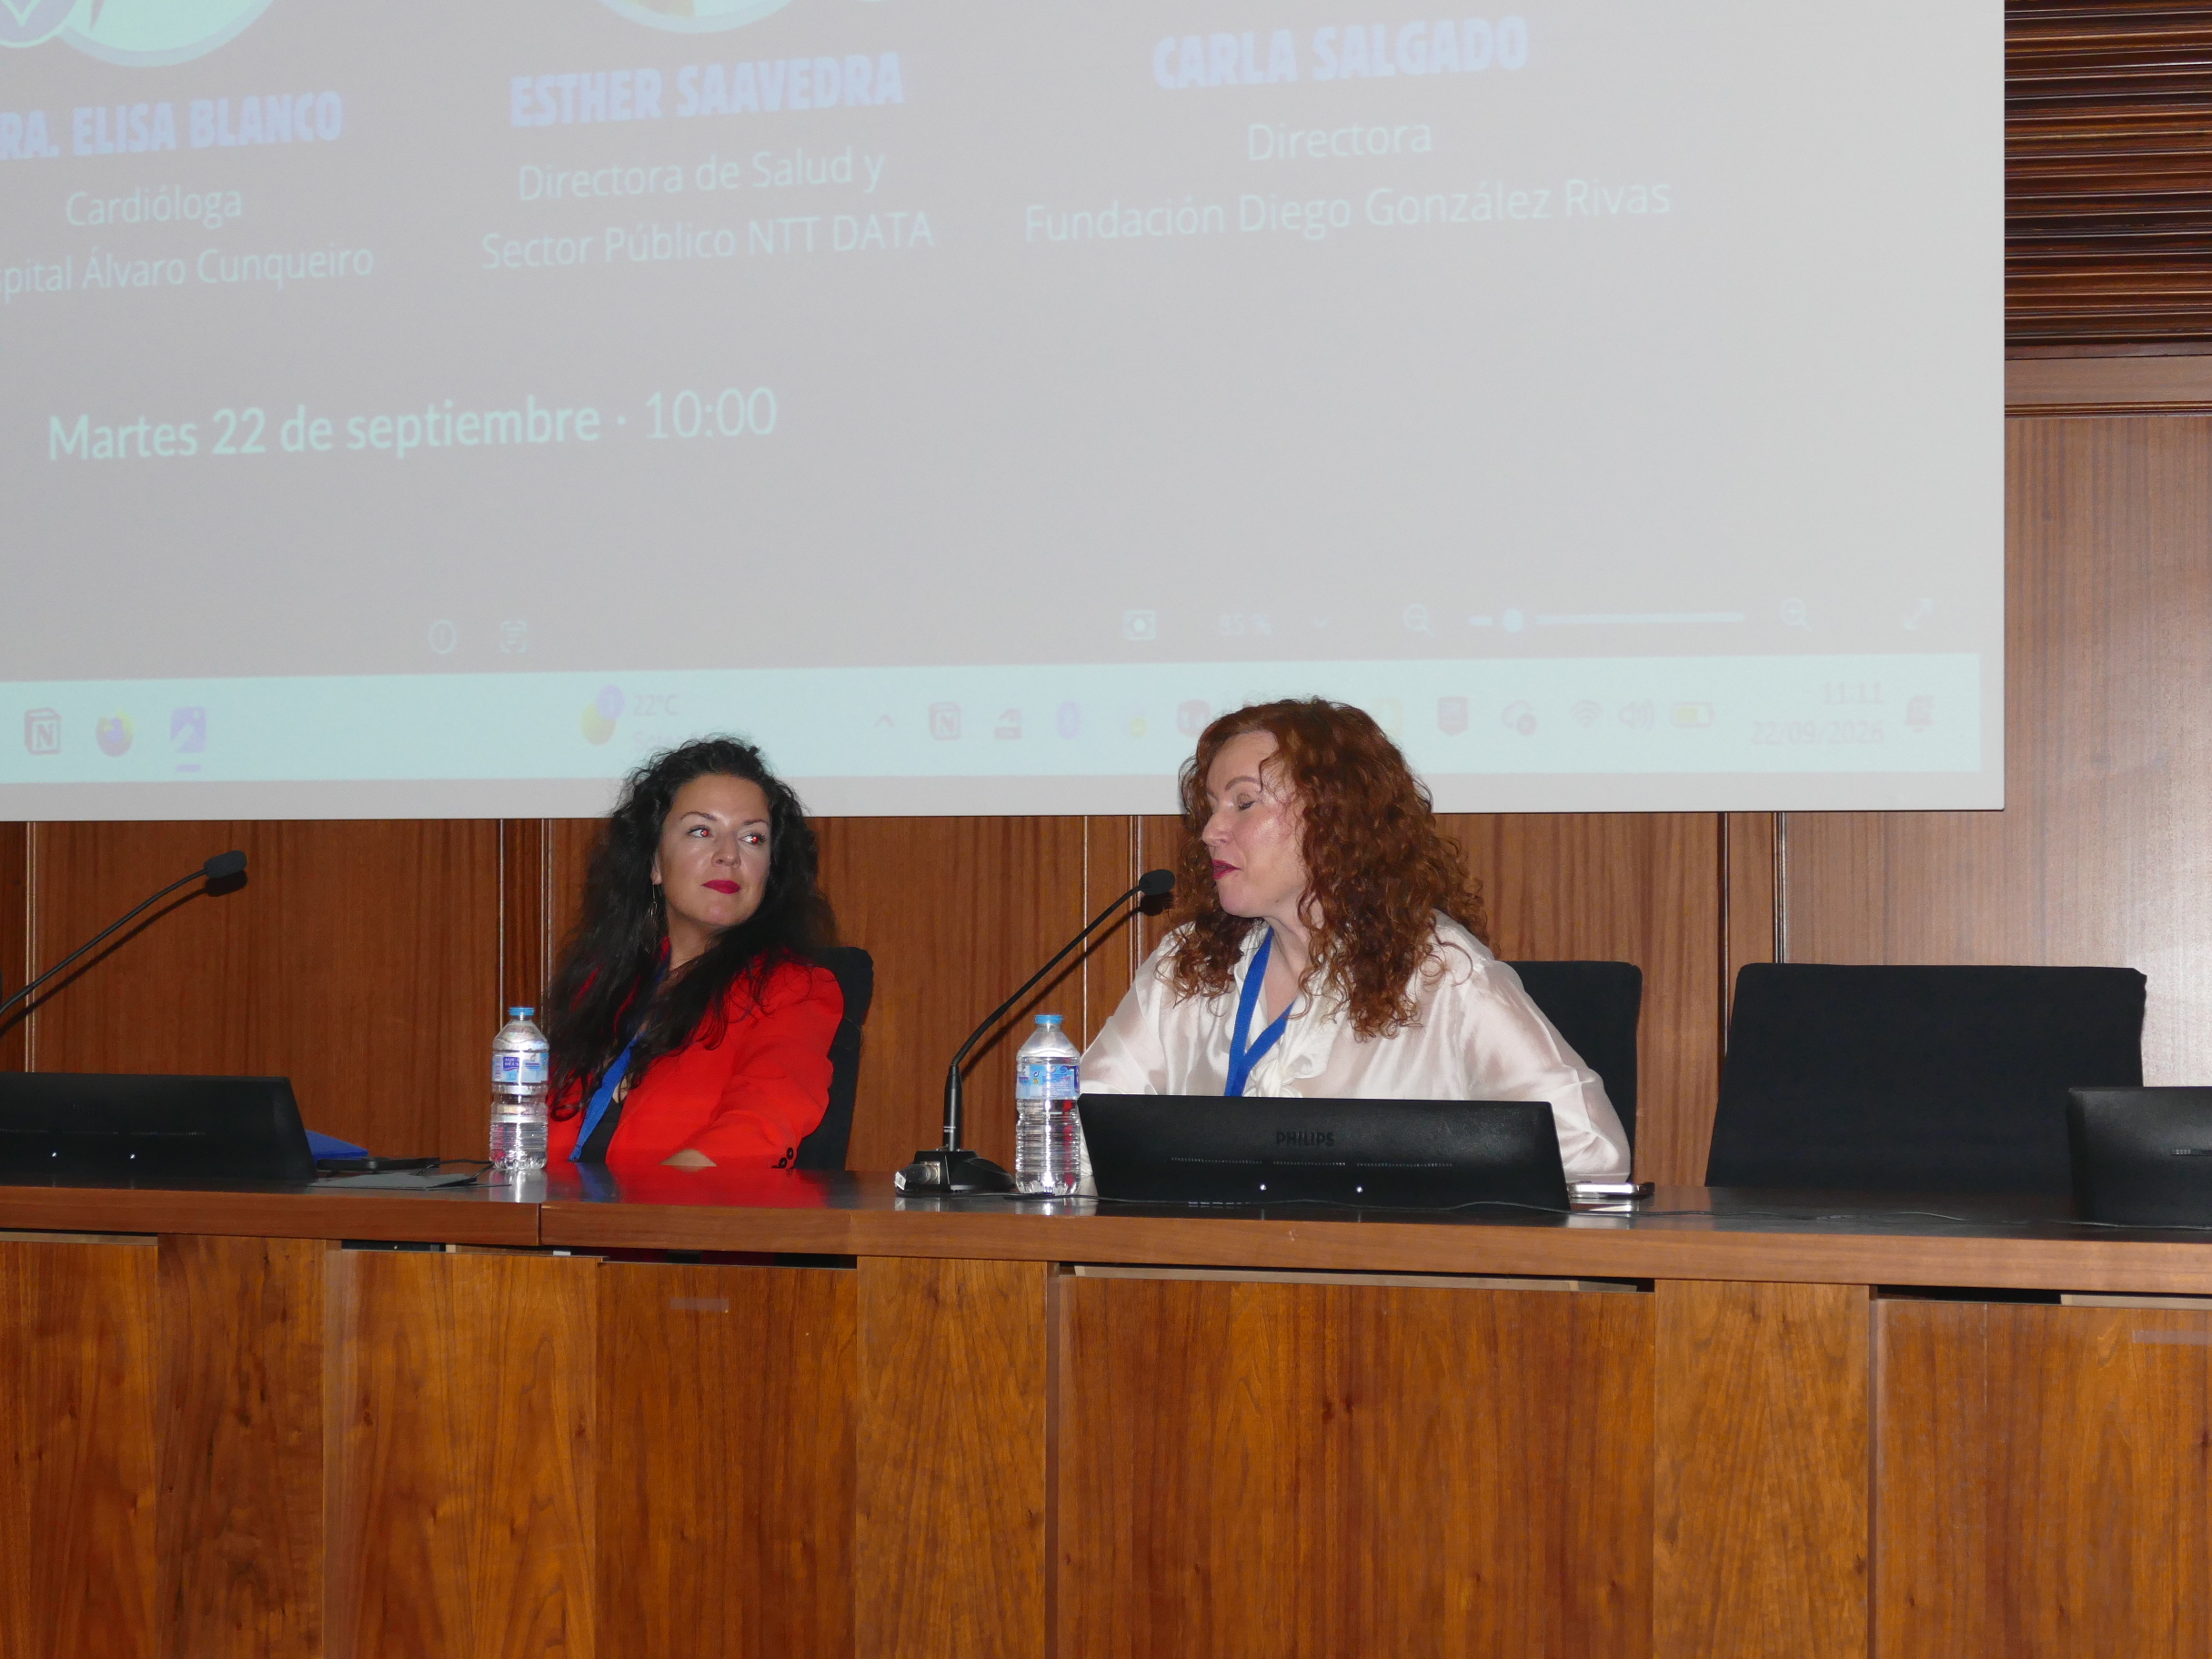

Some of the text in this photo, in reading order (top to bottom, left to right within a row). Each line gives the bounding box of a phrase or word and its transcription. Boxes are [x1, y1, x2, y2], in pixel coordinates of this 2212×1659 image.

[1154, 15, 1530, 89] CARLA SALGADO
[510, 52, 906, 128] ESTHER SAAVEDRA
[73, 101, 176, 156] ELISA
[189, 90, 344, 148] BLANCO
[1248, 124, 1433, 161] Directora
[518, 146, 885, 201] Directora de Salud y
[65, 184, 244, 230] Cardióloga
[1026, 178, 1671, 241] Fundación Diego González Rivas
[482, 212, 934, 269] Sector Público NTT DATA
[0, 243, 375, 305] pital Álvaro Cunqueiro
[50, 414, 198, 460] Martes
[213, 407, 266, 454] 22
[280, 405, 333, 452] de
[347, 395, 600, 458] septiembre
[645, 386, 779, 439] 10:00
[1823, 681, 1885, 705] 11:11
[1751, 719, 1885, 746] 22/09/2026
[1275, 1131, 1334, 1147] PHILIPS
